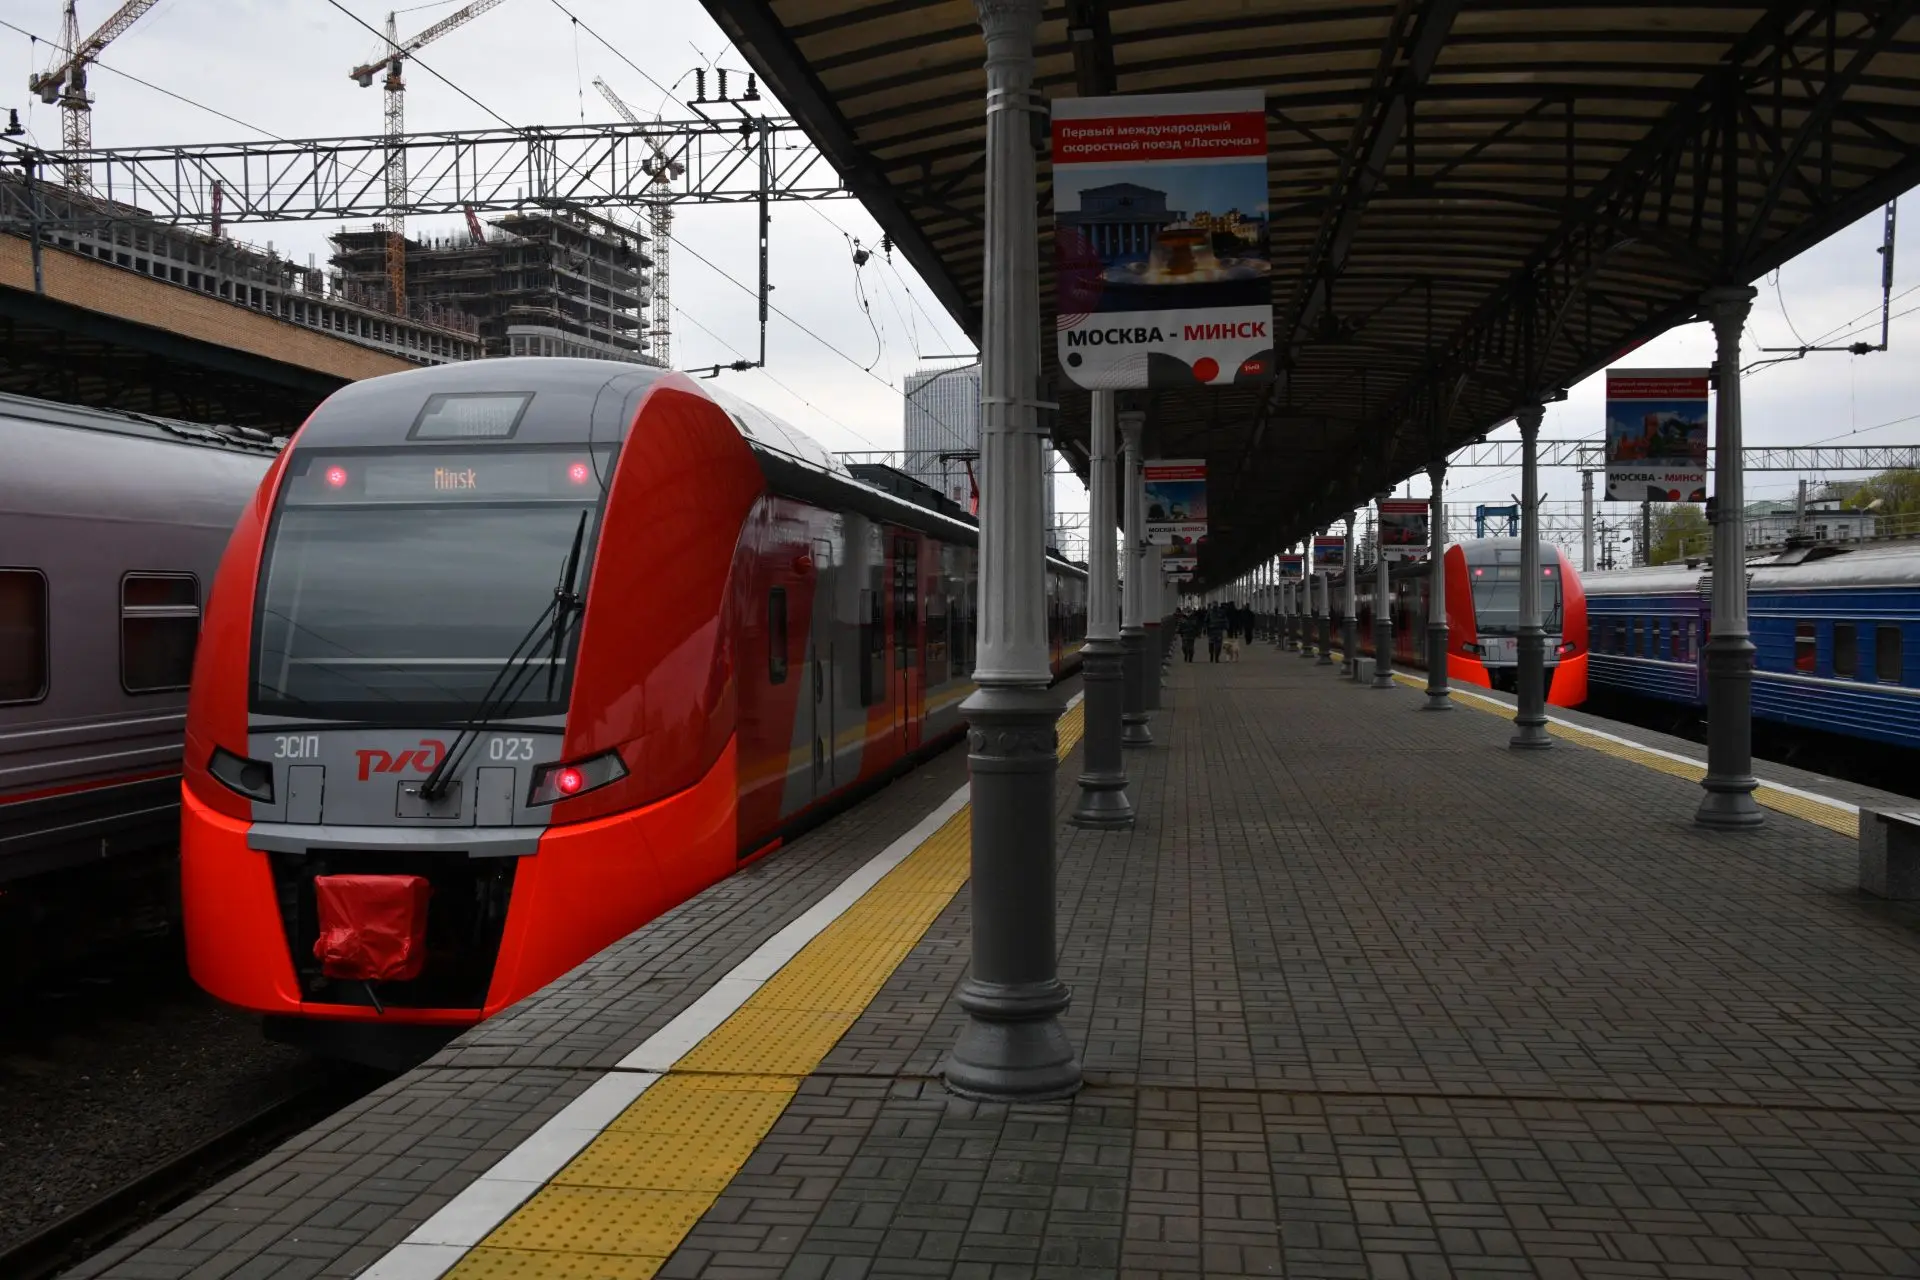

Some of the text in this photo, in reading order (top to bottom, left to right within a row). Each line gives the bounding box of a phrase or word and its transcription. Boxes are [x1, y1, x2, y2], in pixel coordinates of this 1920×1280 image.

[1062, 121, 1231, 139] Первый международный
[1063, 140, 1139, 153] скоростной
[1142, 138, 1181, 151] поезд
[1067, 326, 1164, 346] МОСКВА
[1184, 321, 1267, 341] МИНСК
[434, 467, 476, 490] Minsk
[1609, 473, 1655, 482] МОСКВА
[1665, 473, 1703, 482] МИНСК
[489, 738, 534, 760] 023
